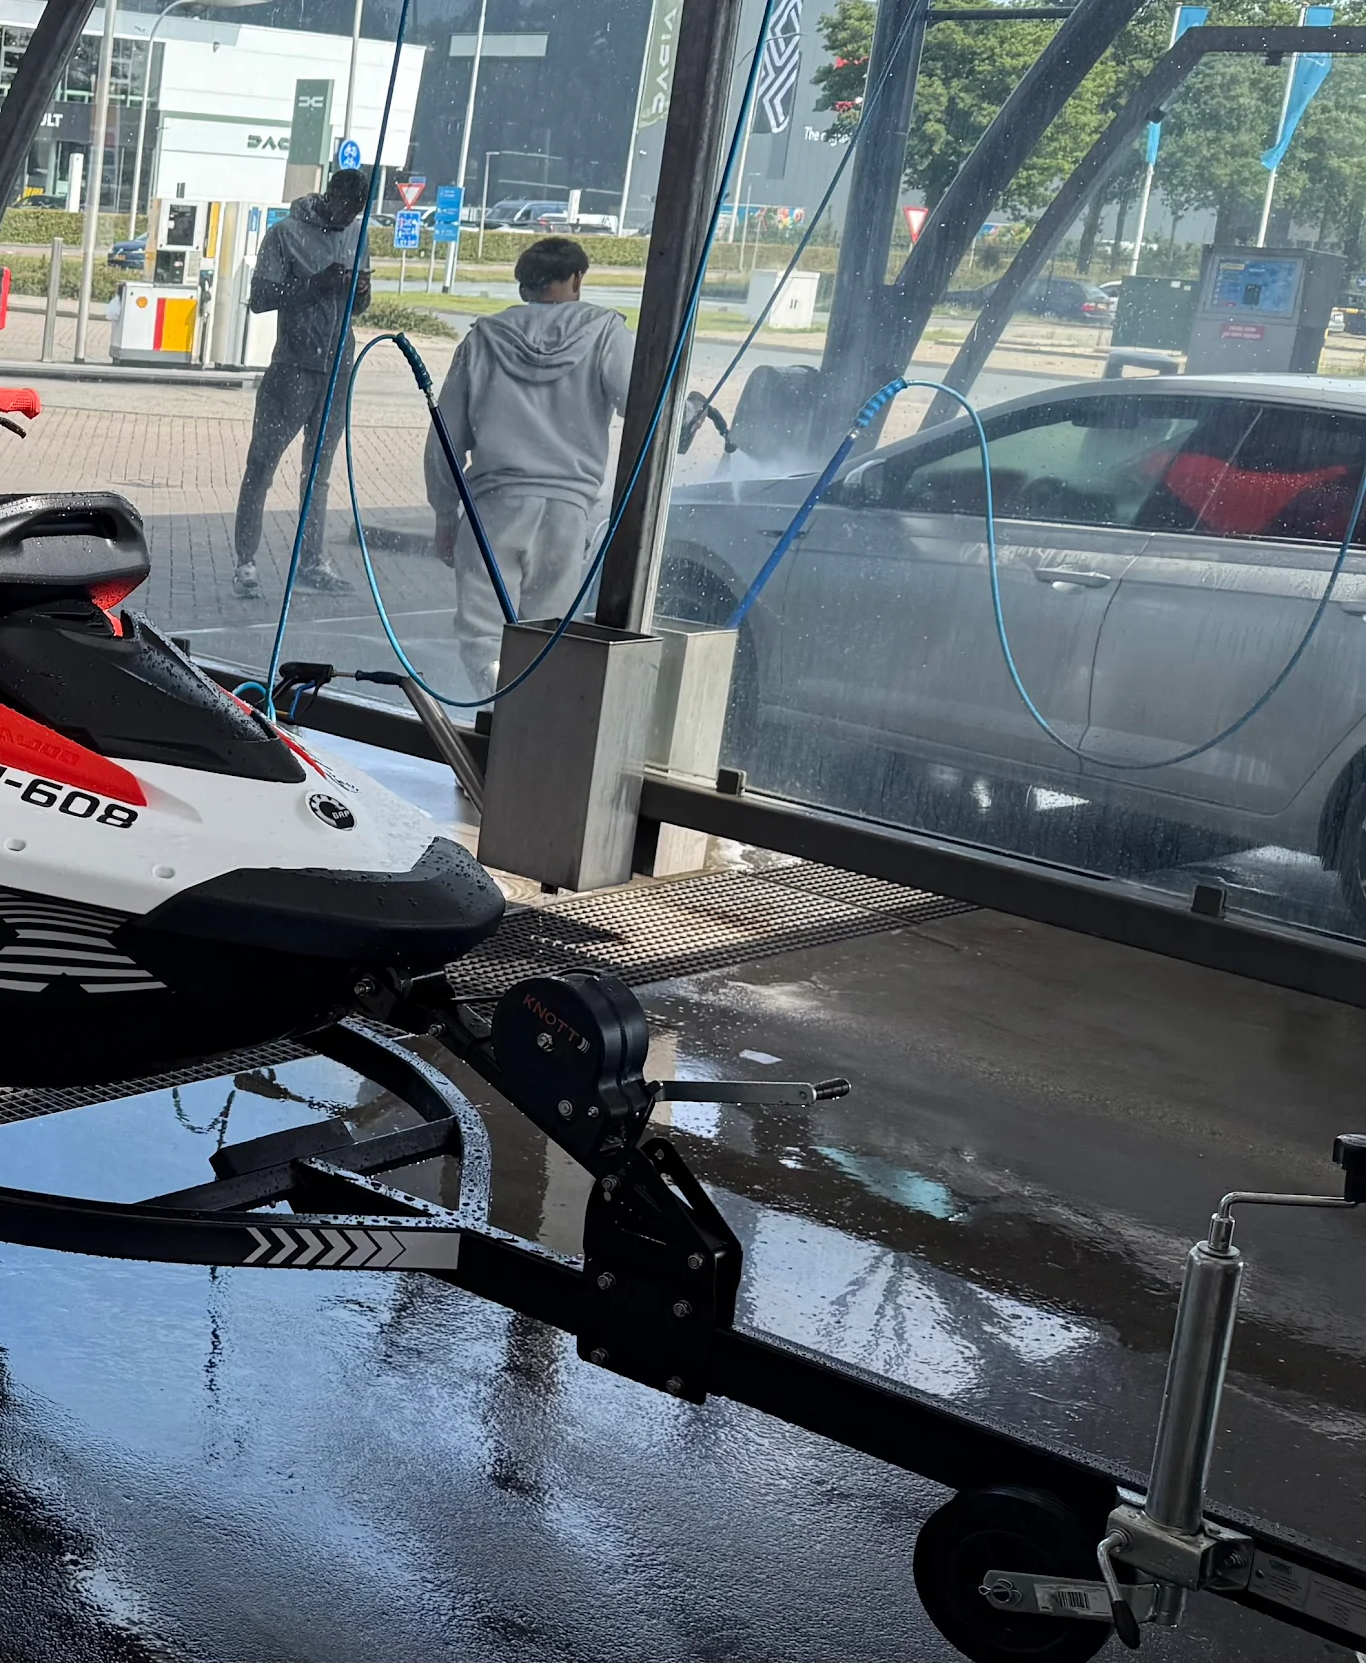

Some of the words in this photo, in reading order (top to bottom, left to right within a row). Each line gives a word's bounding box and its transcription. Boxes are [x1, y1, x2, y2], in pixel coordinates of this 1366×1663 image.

[651, 7, 677, 114] DACIA
[247, 134, 291, 151] DAC
[523, 993, 581, 1042] KNOTT
